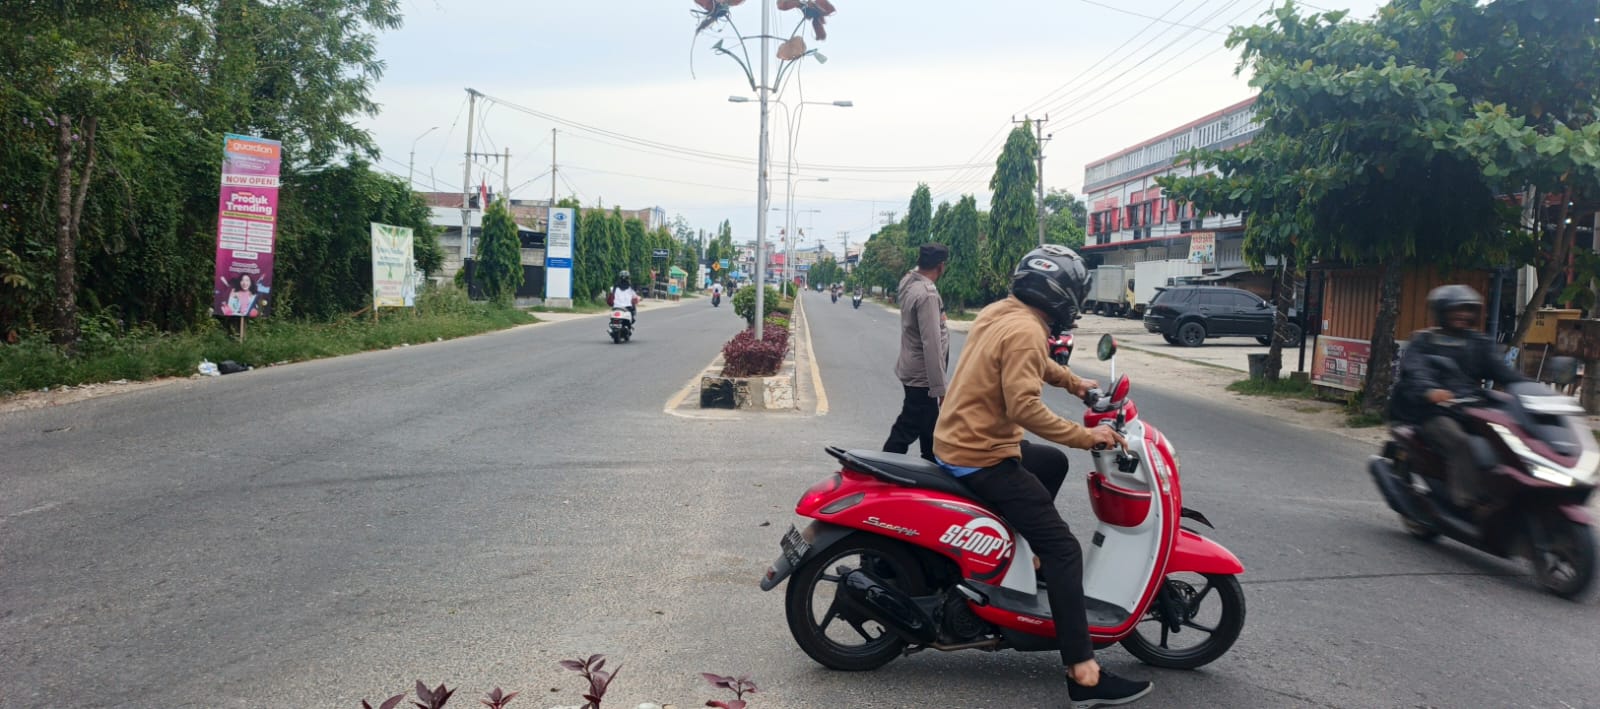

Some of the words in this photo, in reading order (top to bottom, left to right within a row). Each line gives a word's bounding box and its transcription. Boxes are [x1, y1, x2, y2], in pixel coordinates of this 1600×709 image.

[233, 142, 272, 154] guardian
[226, 175, 248, 184] NOW
[231, 194, 268, 204] Produk
[226, 201, 273, 215] Trending
[863, 516, 920, 535] Scoopy
[939, 524, 1013, 560] SCOOPY
